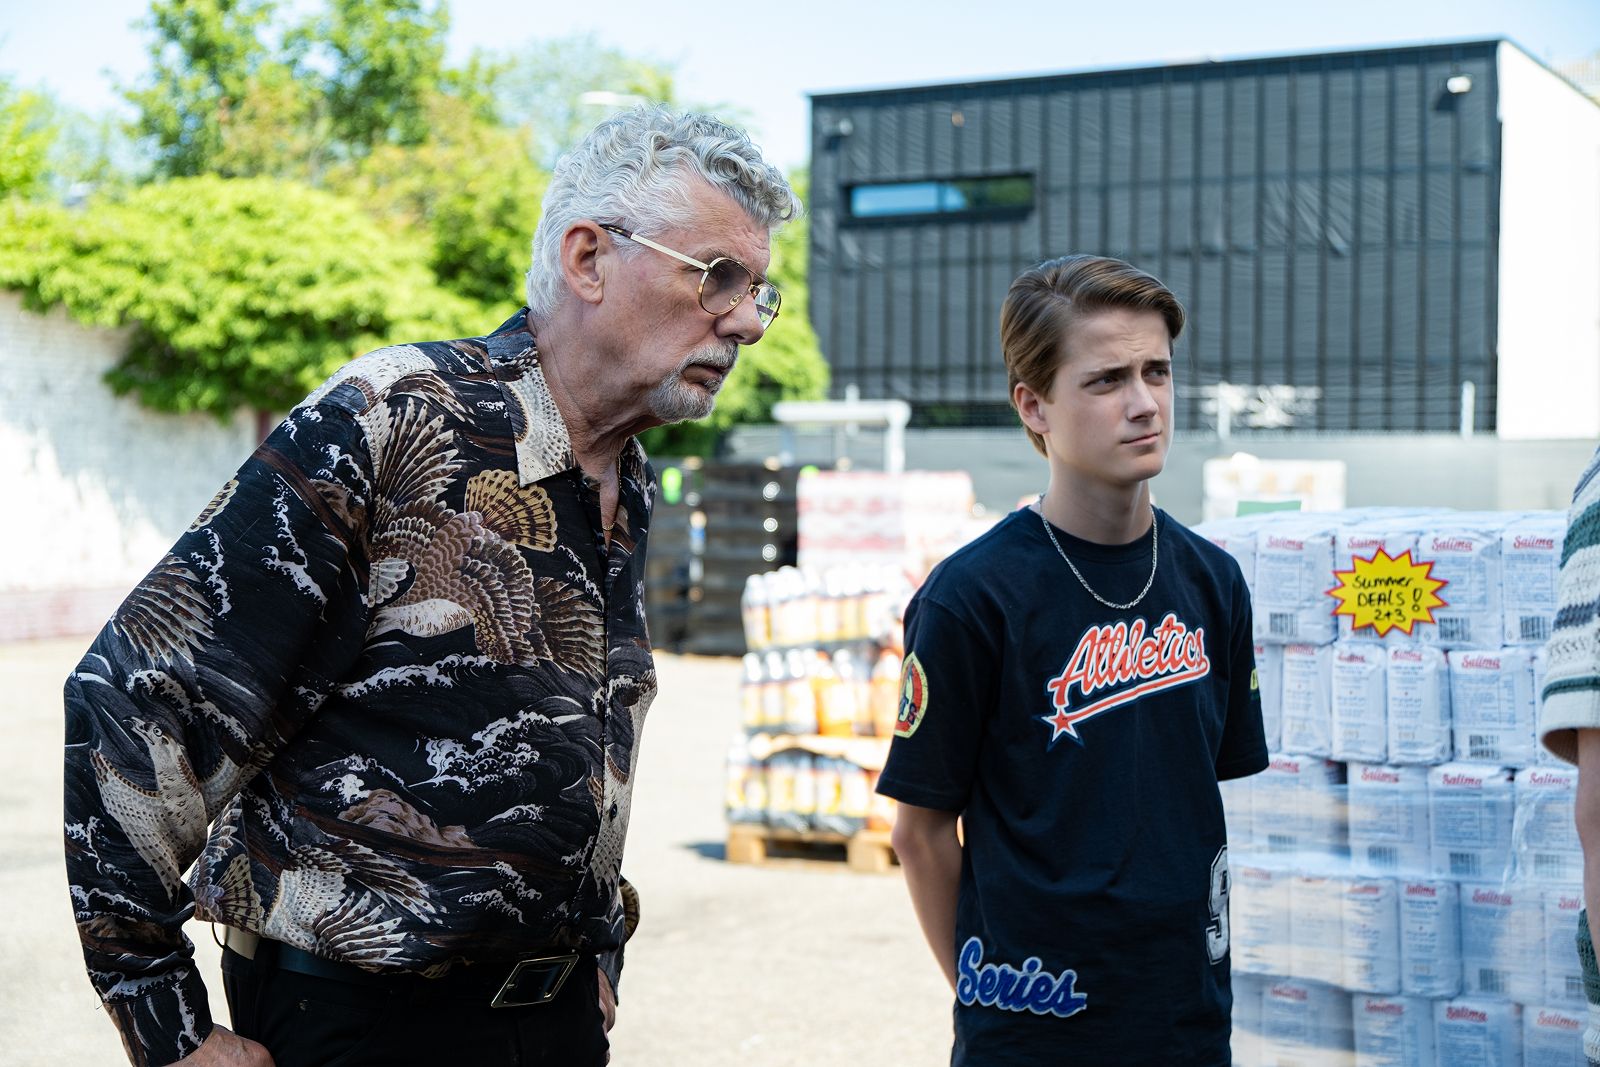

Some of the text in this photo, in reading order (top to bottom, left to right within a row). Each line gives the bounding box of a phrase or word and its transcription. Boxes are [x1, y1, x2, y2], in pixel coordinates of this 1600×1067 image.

[1431, 536, 1473, 552] Salima
[1512, 535, 1554, 550] Salima
[1352, 576, 1414, 589] Summer
[1047, 612, 1211, 708] Athletics
[1460, 655, 1501, 670] Salima
[1441, 773, 1483, 788] Salima
[1528, 771, 1572, 789] Salima
[957, 936, 1088, 1018] Series
[1536, 1009, 1581, 1030] Salima
